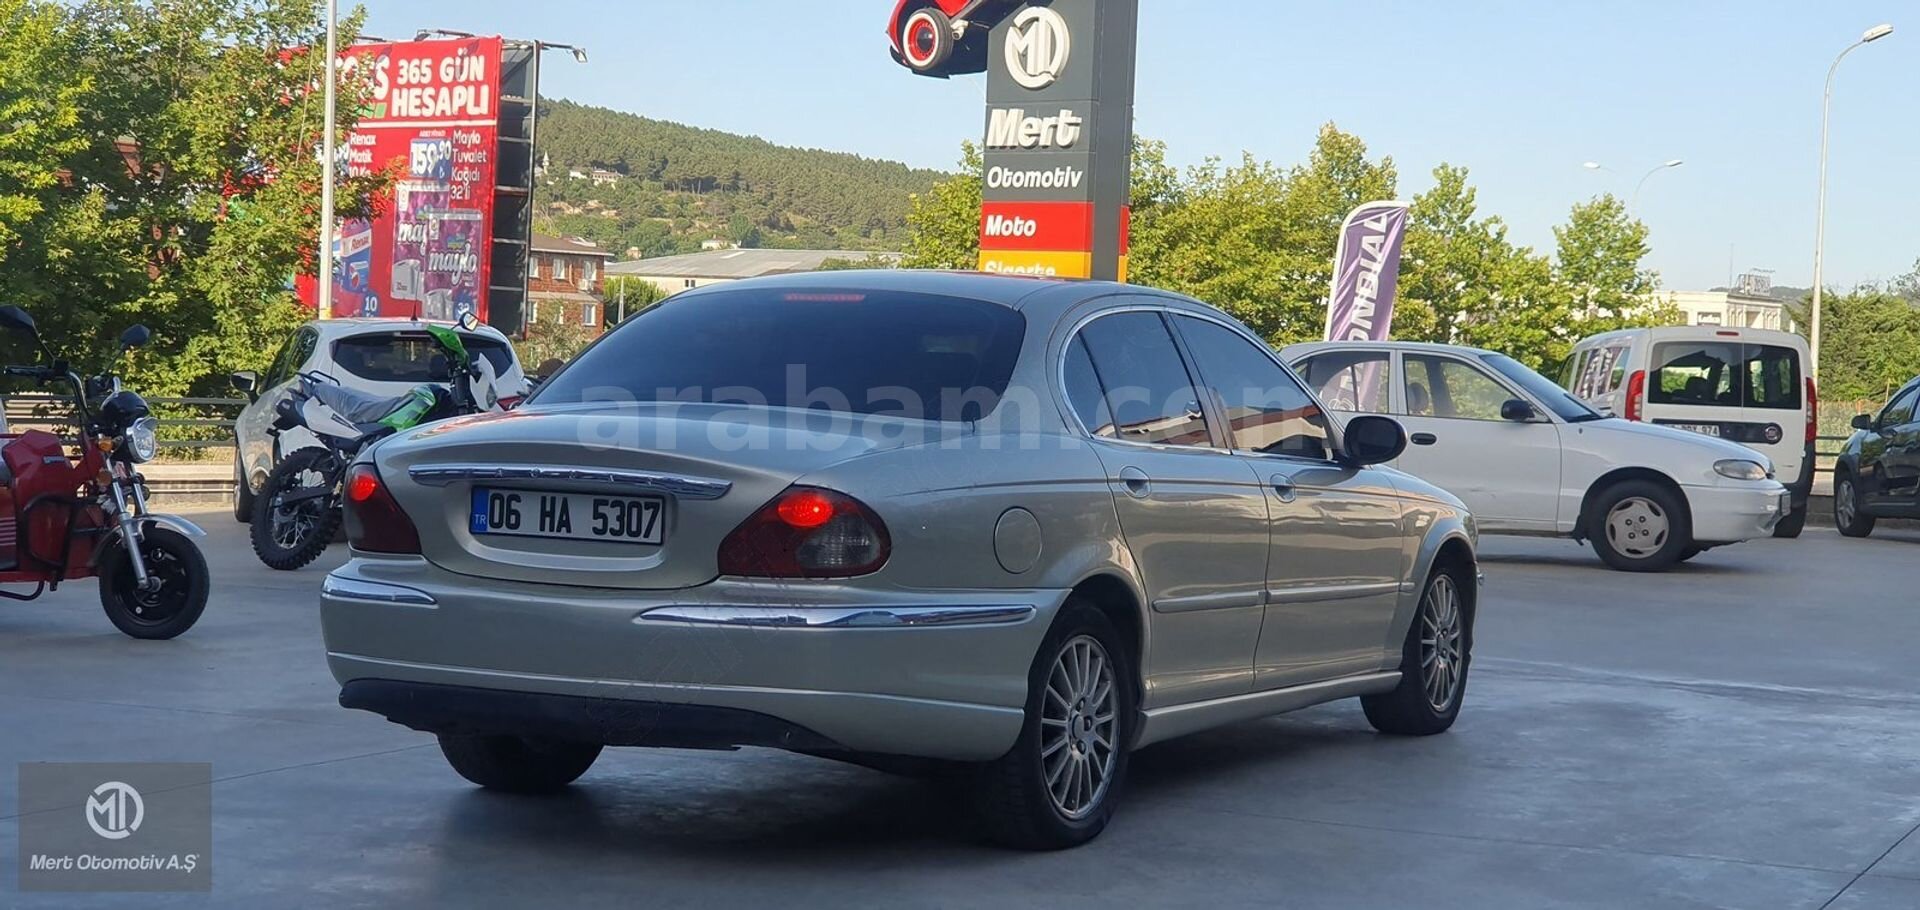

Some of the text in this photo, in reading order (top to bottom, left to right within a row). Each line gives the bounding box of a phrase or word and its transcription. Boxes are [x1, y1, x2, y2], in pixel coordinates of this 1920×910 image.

[397, 57, 432, 85] 365
[439, 47, 485, 83] GÜN
[391, 84, 489, 118] HESAPLI
[350, 132, 377, 145] Renax
[986, 108, 1082, 149] Mert
[349, 148, 373, 163] Matik
[452, 148, 487, 163] Tuvalet
[451, 166, 480, 186] Kağıdı
[986, 166, 1083, 189] Otomotiv
[985, 214, 1037, 237] Moto
[427, 240, 478, 285] maylo
[364, 296, 377, 312] 10
[474, 513, 486, 525] TR
[489, 492, 661, 540] 06 HA 5307
